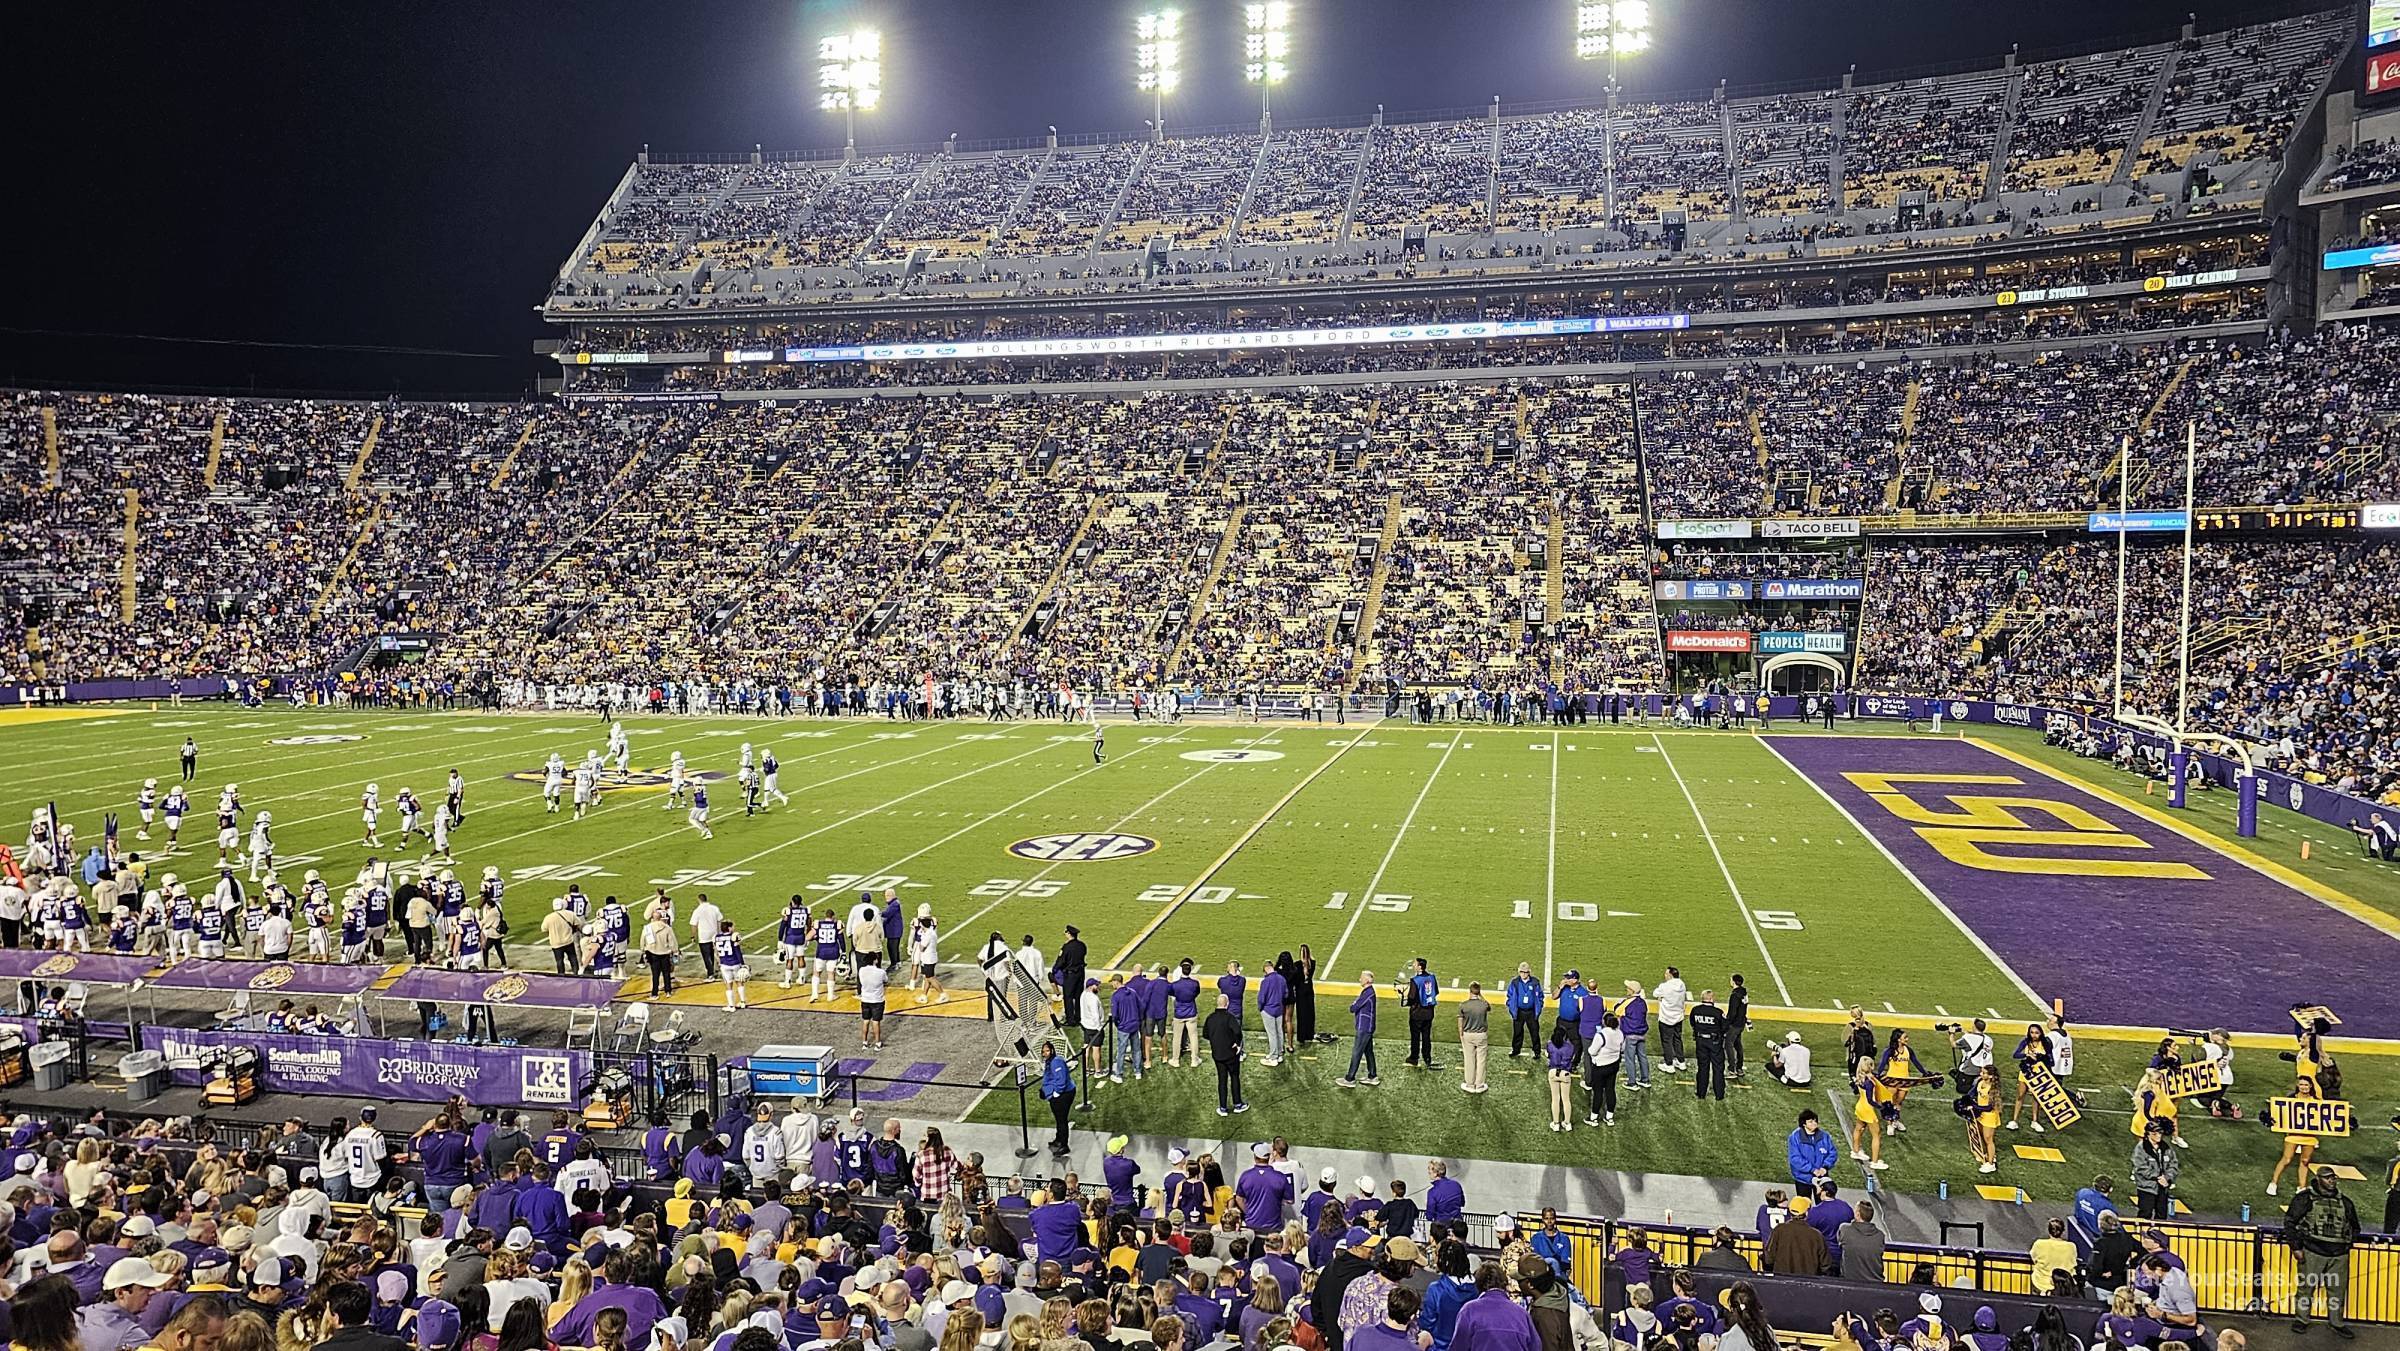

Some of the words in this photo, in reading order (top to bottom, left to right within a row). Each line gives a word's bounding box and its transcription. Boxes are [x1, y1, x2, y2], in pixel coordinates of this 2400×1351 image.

[2343, 324, 2368, 341] 413
[976, 339, 1163, 353] HOLLINGSWORTH
[1181, 333, 1294, 346] RICHARDS
[1313, 331, 1370, 341] FORD
[758, 399, 777, 409] 300
[1675, 523, 1733, 536] EcoSport
[1786, 524, 1821, 534] TACO
[1823, 522, 1855, 533] BELL
[1787, 583, 1859, 596] Marathon
[1672, 636, 1747, 648] McDonald's
[1763, 636, 1803, 649] PEOPLES
[1807, 637, 1842, 649] HEALTH
[1841, 772, 2215, 881] LSU
[1018, 834, 1149, 860] SEC
[511, 865, 605, 881] 40
[649, 870, 758, 886] 35
[806, 875, 909, 891] 30
[967, 879, 1072, 897] 25
[448, 887, 462, 903] 35
[1136, 884, 1235, 904] 20
[1324, 892, 1413, 912] 15
[174, 903, 193, 920] 38
[371, 895, 386, 911] 96
[573, 900, 584, 916] 18
[1511, 900, 1599, 921] 10
[605, 912, 623, 929] 76
[790, 913, 807, 929] 68
[1752, 910, 1805, 931] 5
[463, 929, 480, 947] 45
[818, 927, 836, 944] 98
[716, 940, 732, 957] 54
[1694, 1015, 1716, 1025] POLICE
[268, 1047, 342, 1064] SouthernAIR
[305, 1066, 342, 1076] COOLING
[401, 1059, 481, 1080] BRIDGEWAY
[756, 1073, 791, 1082] POWERADE
[291, 1074, 329, 1083] PLUMBING
[416, 1074, 466, 1088] HOSPICE
[526, 1090, 567, 1100] RENTALS
[2275, 1101, 2347, 1133] TIGERS
[353, 1145, 363, 1168] 9
[548, 1142, 560, 1163] 2
[754, 1144, 765, 1163] 9
[848, 1146, 861, 1168] 3
[1219, 1298, 1232, 1319] 7
